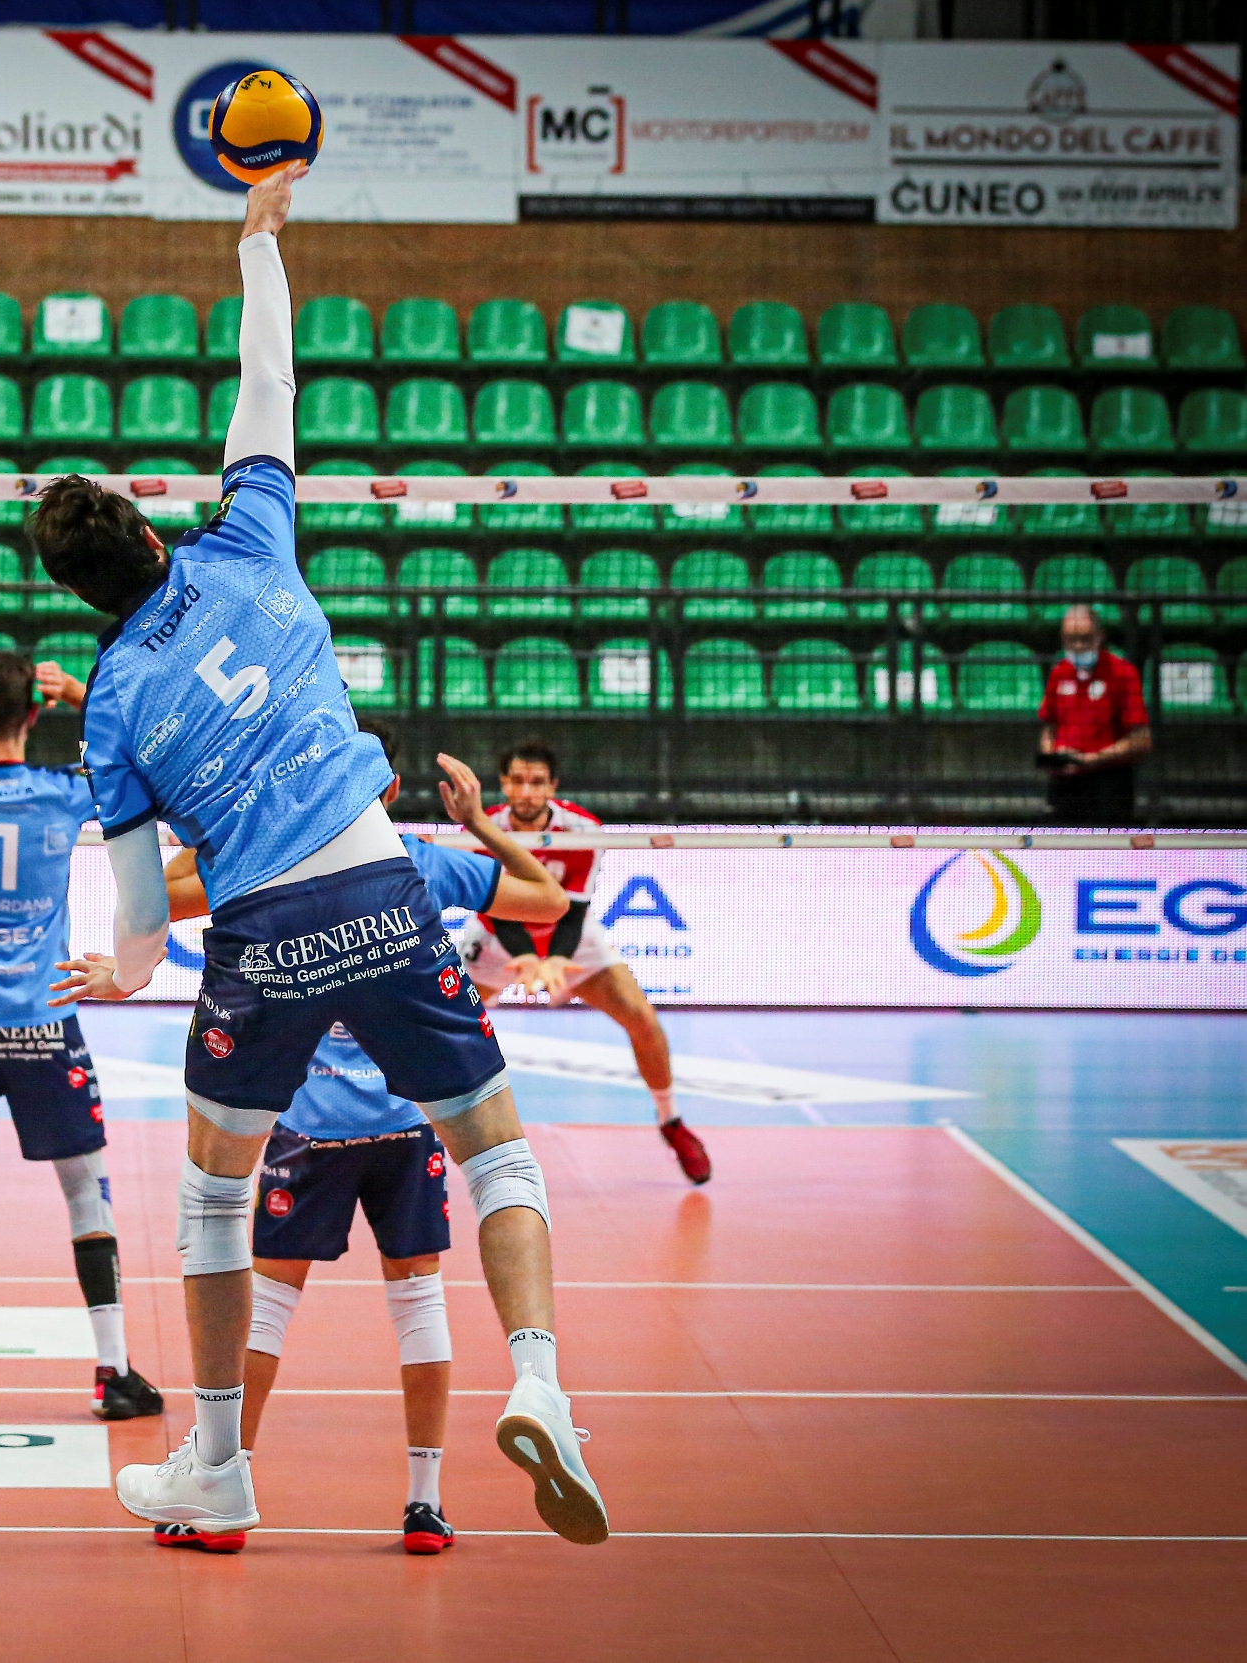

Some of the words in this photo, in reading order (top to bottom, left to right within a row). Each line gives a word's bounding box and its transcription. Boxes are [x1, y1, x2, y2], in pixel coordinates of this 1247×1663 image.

[924, 124, 1051, 152] MONDO
[1057, 126, 1116, 152] DEL
[890, 180, 1046, 216] CUNEO
[139, 583, 201, 653] TIOZZO
[194, 635, 270, 720] 5
[276, 906, 419, 969] GENERALI
[244, 970, 293, 985] Agenzia
[296, 954, 363, 983] Generale
[367, 945, 382, 961] di
[384, 935, 421, 956] Cuneo
[262, 987, 305, 1000] Cavallo,
[306, 979, 346, 997] Parola,
[346, 966, 391, 983] Lavigna
[393, 956, 411, 970] snc
[444, 974, 456, 990] CN
[195, 1390, 242, 1402] PALDING
